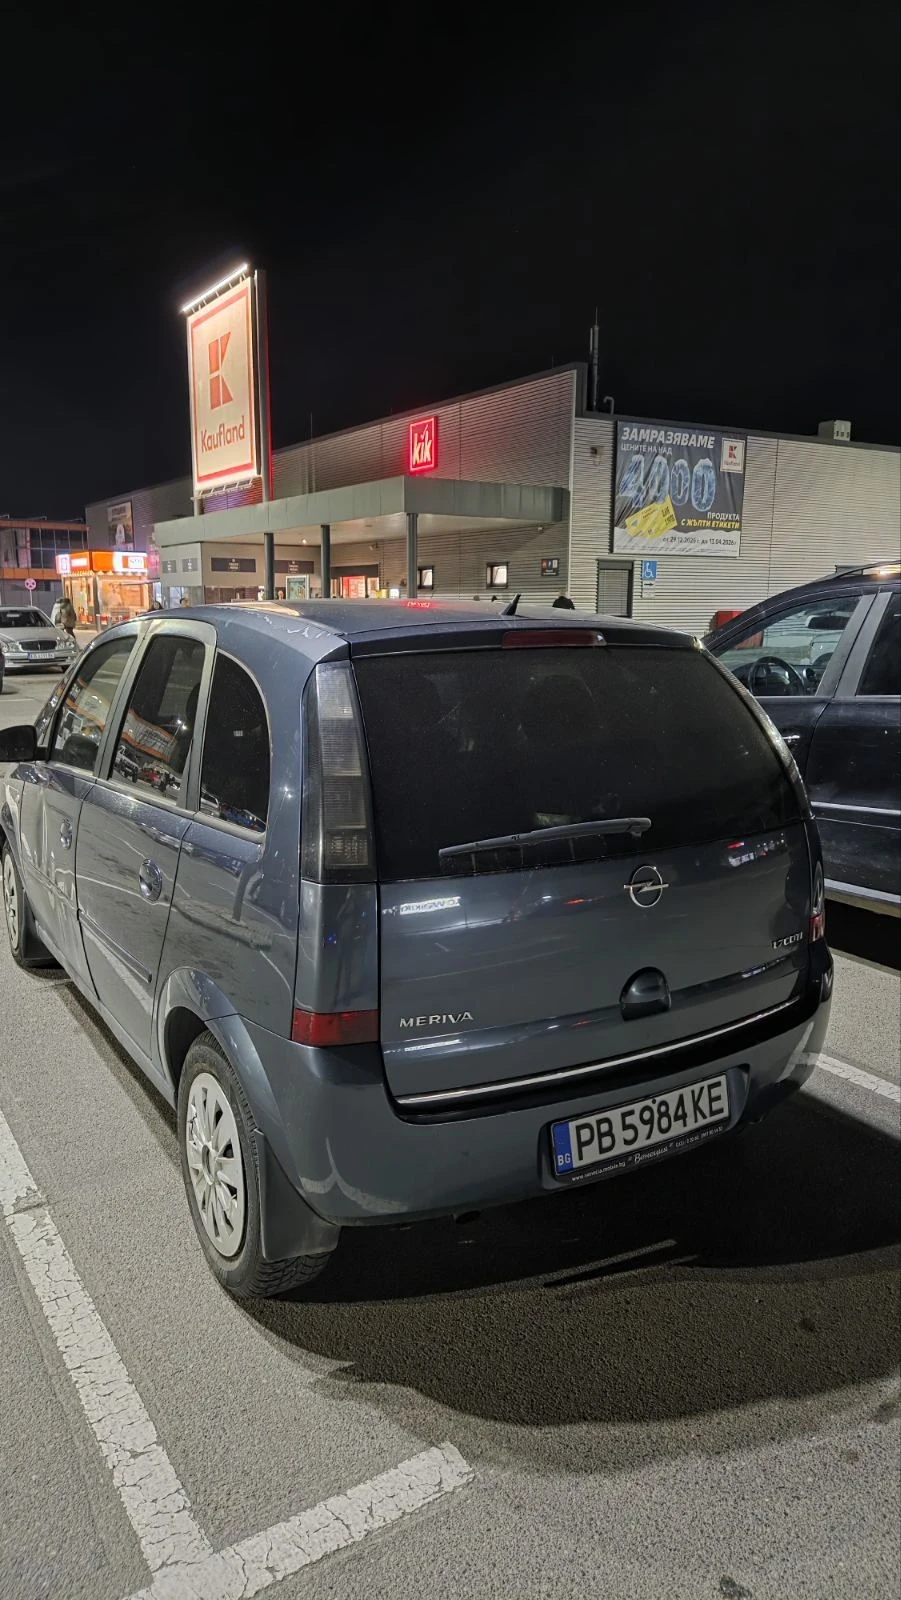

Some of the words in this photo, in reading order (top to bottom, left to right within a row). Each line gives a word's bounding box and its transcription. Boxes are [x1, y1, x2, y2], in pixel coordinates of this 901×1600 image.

[201, 415, 246, 453] Kaufland
[621, 427, 716, 449] ЗАМРАЗЯВАМЕ
[621, 443, 647, 453] ЦЕНИТЕ
[648, 445, 658, 453] НА
[659, 446, 673, 455] НАД
[707, 511, 740, 521] ПРОДУКТА
[687, 519, 711, 528] ЖЪЛТИ
[712, 520, 740, 529] ЕТИКЕТИ
[399, 1011, 474, 1028] MERIVA
[557, 1153, 572, 1167] BG
